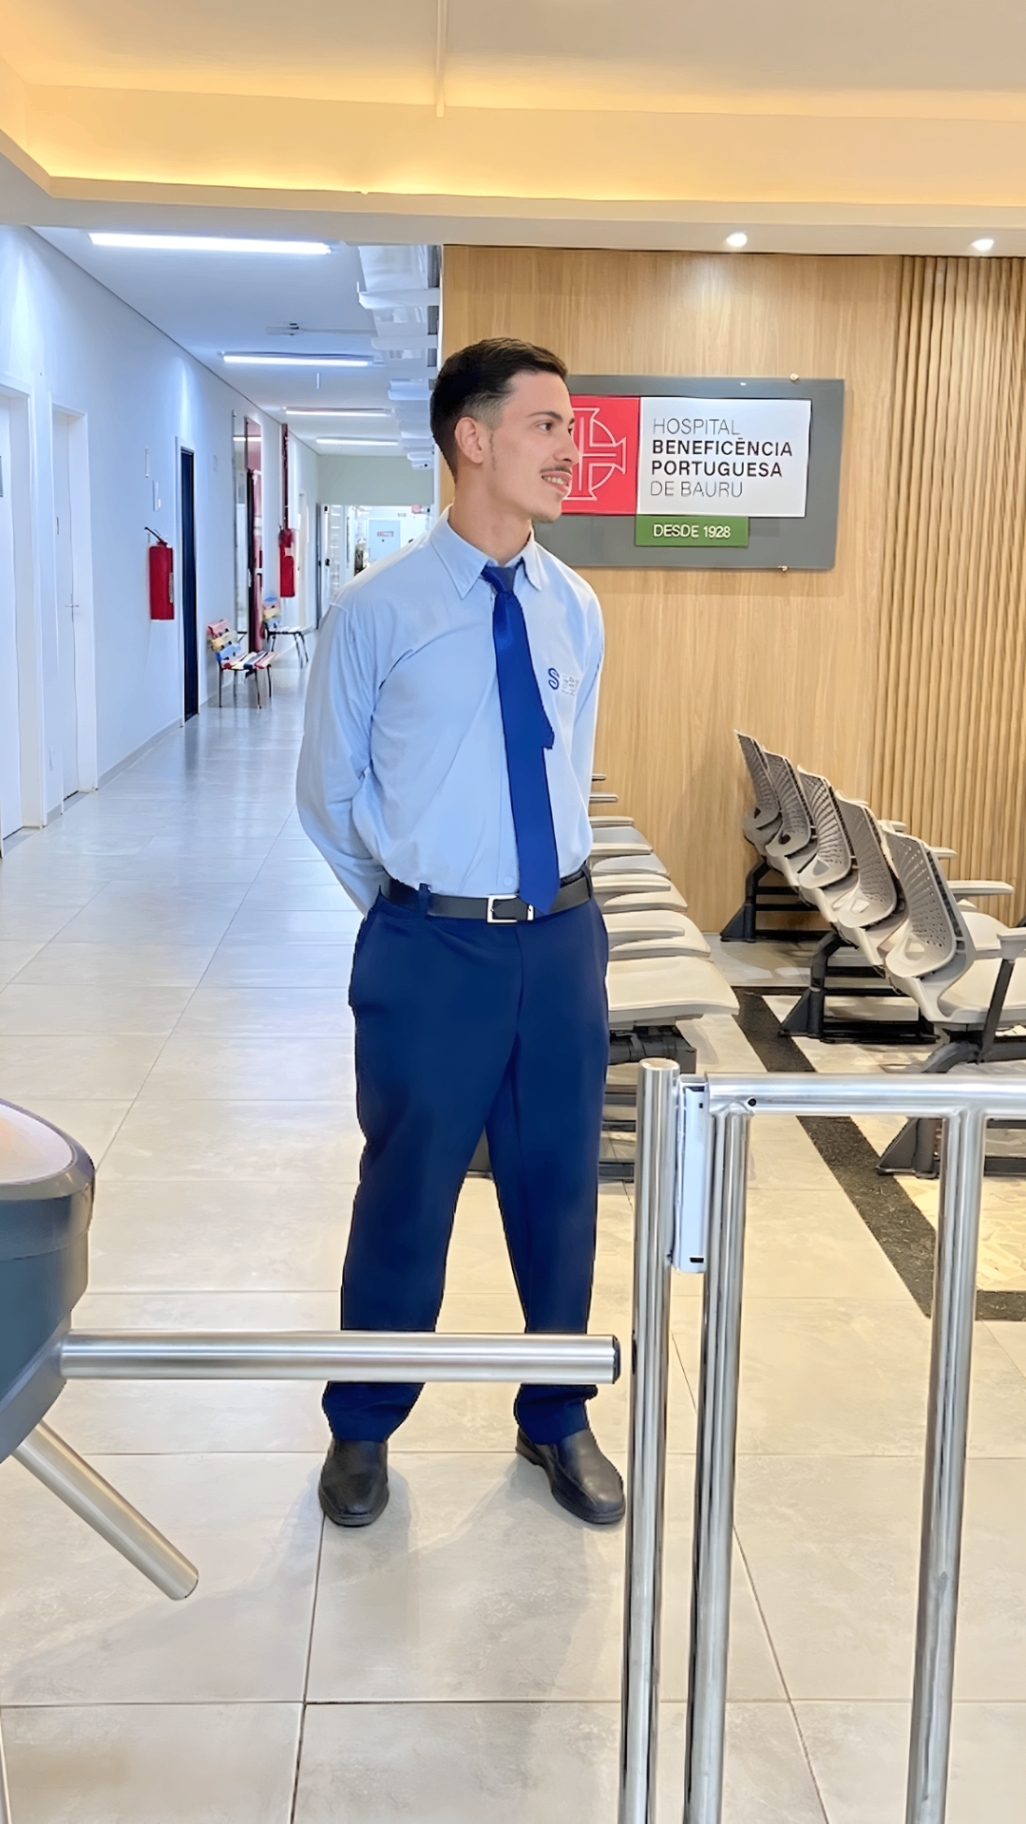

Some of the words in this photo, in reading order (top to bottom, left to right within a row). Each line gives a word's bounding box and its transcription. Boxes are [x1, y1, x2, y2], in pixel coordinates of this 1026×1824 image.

[653, 418, 741, 435] HOSPITAL
[652, 460, 782, 477] PORTUGUESA
[650, 481, 674, 496] DE
[681, 481, 743, 498] BAURU
[653, 524, 700, 538] DESDE
[703, 525, 731, 539] 1928
